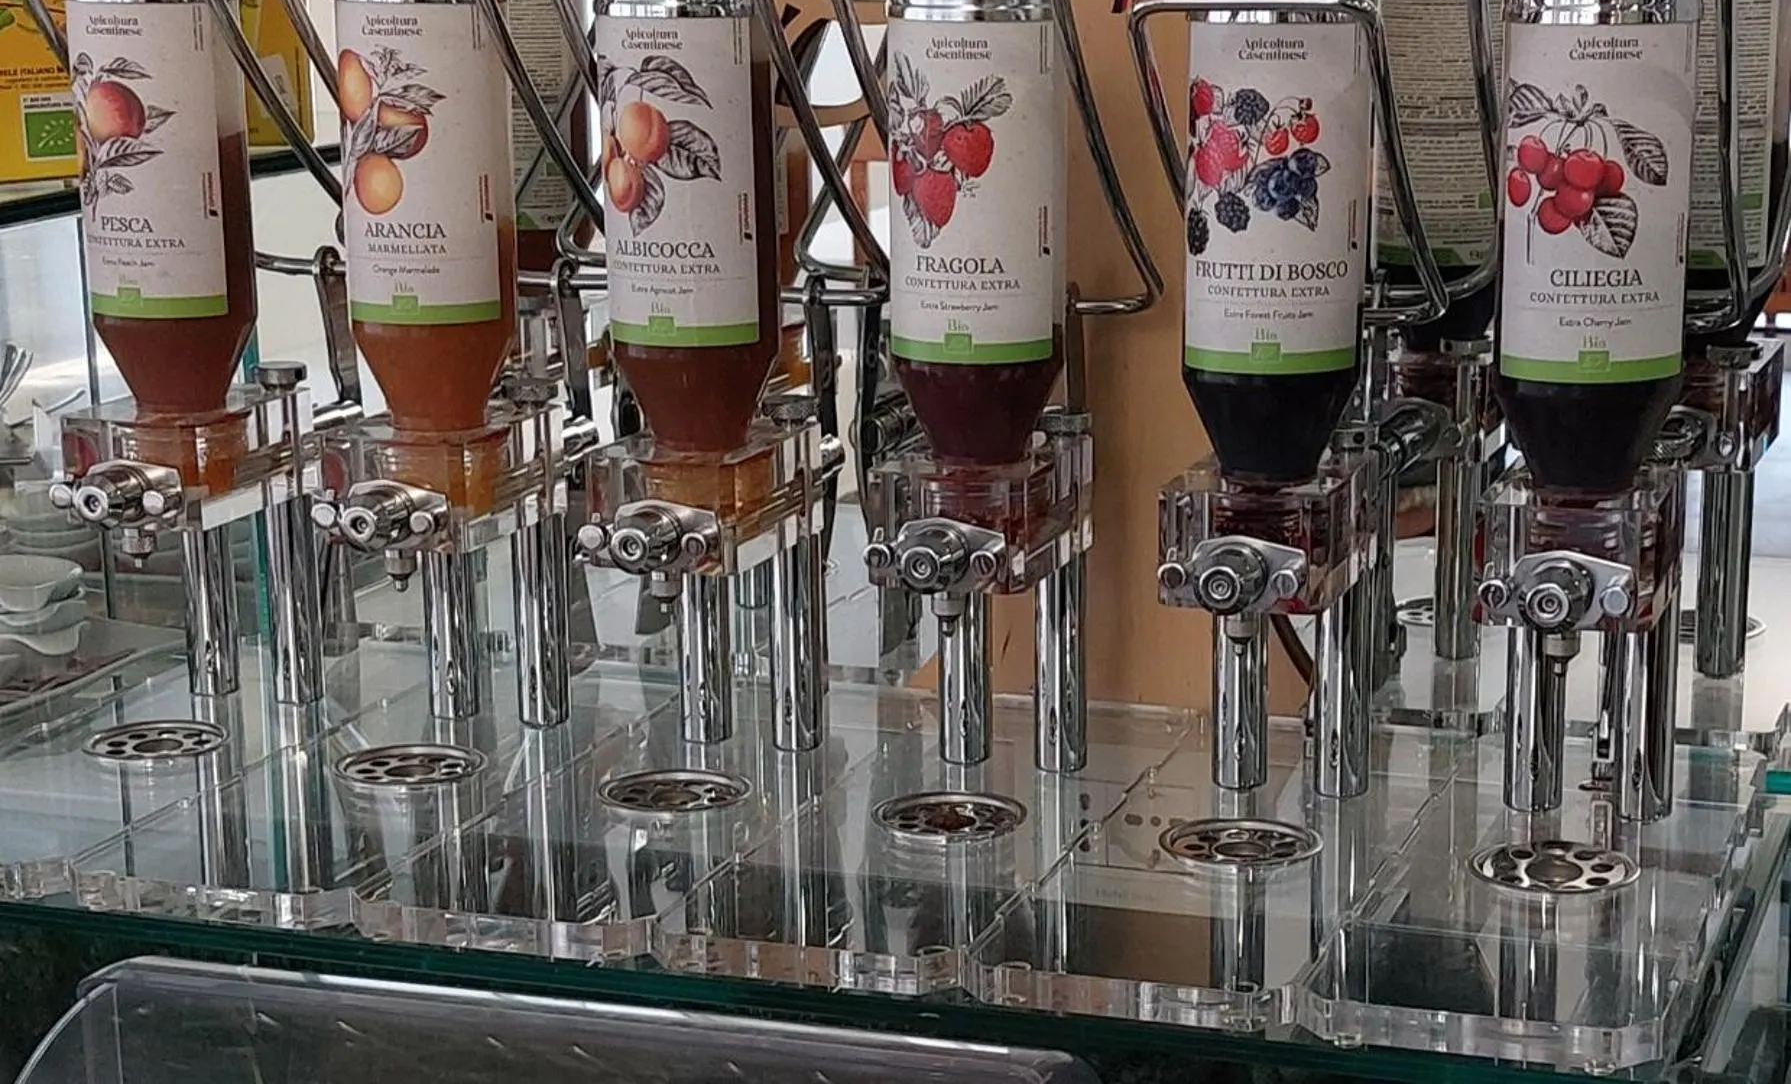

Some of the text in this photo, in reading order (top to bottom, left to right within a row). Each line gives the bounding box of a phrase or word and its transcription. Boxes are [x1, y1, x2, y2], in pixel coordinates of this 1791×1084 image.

[101, 216, 153, 233] PESCA
[364, 222, 447, 239] ARANCIA
[145, 238, 185, 248] EXTRA
[368, 243, 446, 255] MARMELLATA
[616, 239, 715, 259] ALBICOCCA
[681, 263, 721, 275] EXTRA
[916, 255, 1005, 274] FRAGOLA
[1195, 260, 1348, 281] FRUTTI DI BOSCO
[981, 279, 1021, 291] EXTRA
[1550, 269, 1643, 288] CILIEGIA
[1208, 285, 1330, 298] CONFETTURA EXTRA
[1530, 292, 1660, 305] CONFETTURA EXTRA
